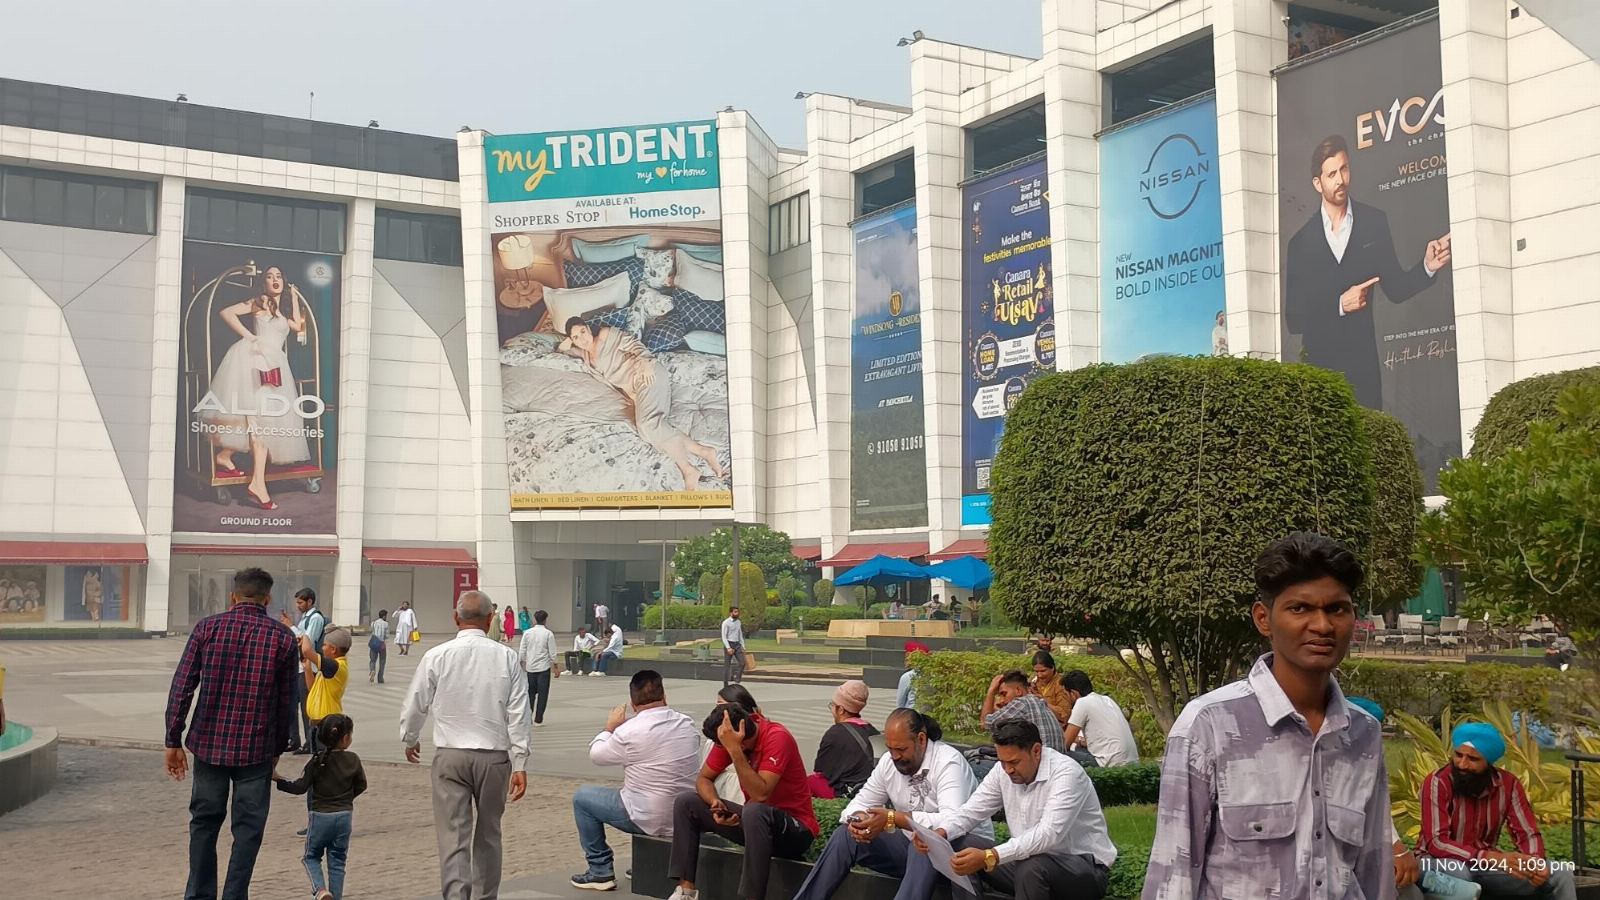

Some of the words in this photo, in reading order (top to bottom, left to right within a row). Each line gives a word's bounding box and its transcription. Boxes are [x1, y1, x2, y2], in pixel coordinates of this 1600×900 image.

[492, 149, 556, 192] my
[545, 125, 711, 169] TRIDENT
[636, 171, 654, 184] my
[1140, 160, 1209, 192] NISSAN
[1379, 183, 1390, 192] THE
[1391, 177, 1406, 188] NEW
[1407, 172, 1425, 183] FACE
[1427, 170, 1437, 178] OF
[576, 198, 621, 208] AVAILABLE
[622, 197, 637, 205] AT:
[494, 214, 560, 228] SHOPPERS
[566, 210, 600, 224] STOP
[1002, 234, 1020, 246] Make
[1021, 230, 1032, 240] the
[1116, 252, 1131, 264] NEW
[1116, 256, 1163, 280] NISSAN
[1168, 242, 1222, 266] MAGNIT
[1005, 269, 1031, 283] Canara
[1116, 280, 1150, 300] BOLD
[1154, 269, 1197, 292] INSIDE
[1002, 278, 1033, 302] Retail
[870, 356, 895, 370] LIMITED
[896, 351, 922, 364] EDITION
[864, 366, 906, 382] EXTRAVAGANT
[191, 390, 326, 419] ALDO
[191, 422, 232, 434] Shoes
[236, 426, 243, 434] &
[246, 423, 324, 438] Accessories
[877, 439, 898, 454] 91050
[901, 435, 923, 451] 91050
[220, 517, 260, 526] GROUND
[262, 518, 292, 526] FLOOR
[460, 574, 471, 586] 1
